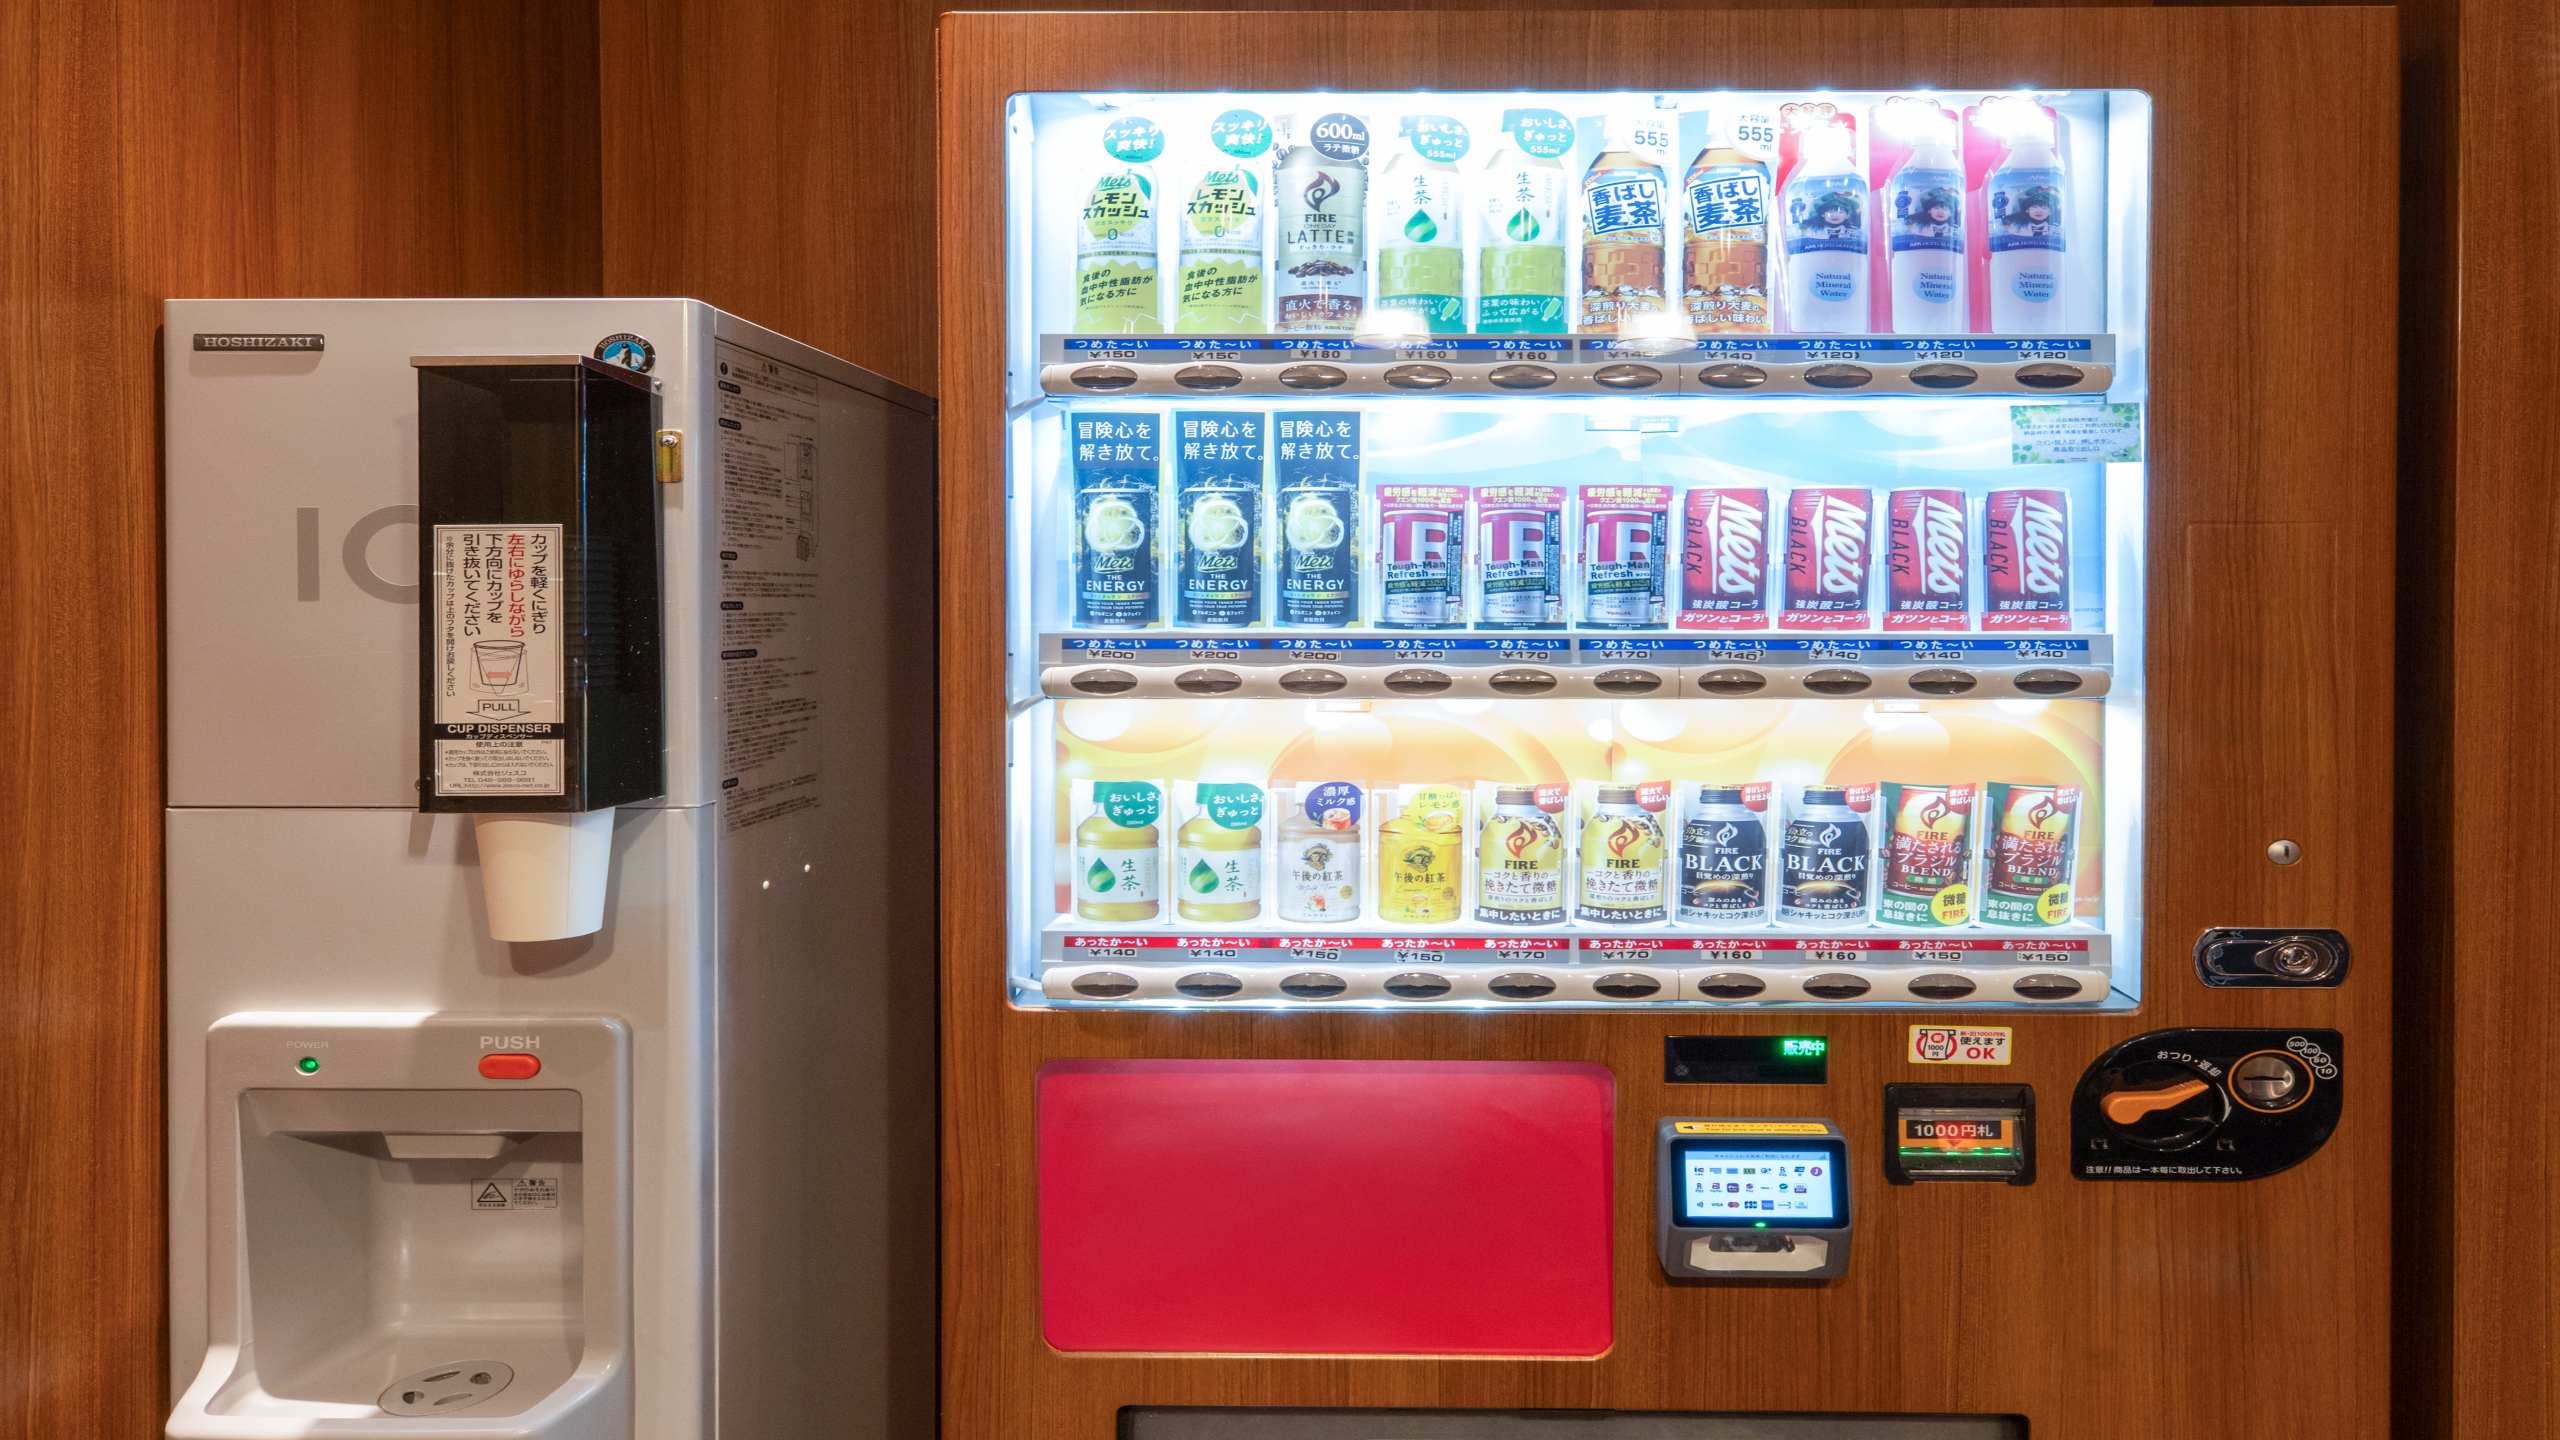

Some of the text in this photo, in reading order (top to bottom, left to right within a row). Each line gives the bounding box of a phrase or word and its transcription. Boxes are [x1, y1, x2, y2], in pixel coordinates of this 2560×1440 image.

[1427, 150, 1456, 159] 555ml
[1530, 146, 1560, 154] 555ml
[1197, 189, 1245, 201] レモン
[1413, 175, 1432, 204] 生茶
[1592, 184, 1654, 206] 香ばし
[1091, 193, 1137, 206] レモン
[1083, 206, 1149, 220] スカッシュ
[1305, 214, 1337, 222] FIRE
[1594, 201, 1658, 229] 麦茶
[1697, 198, 1763, 228] 麦茶
[1288, 229, 1344, 244] LATTE
[1083, 269, 1111, 284] 食後の
[1920, 272, 1952, 280] Natural
[2019, 272, 2052, 280] Natural
[1815, 281, 1852, 289] Mineral
[1920, 282, 1952, 290] Mineral
[1080, 288, 1137, 306] 気になる方に
[1182, 286, 1243, 303] 気になる方に
[1820, 290, 1848, 298] Water
[1924, 290, 1950, 298] Water
[2023, 290, 2050, 298] Water
[1482, 298, 1541, 307] 茶葉の味わい
[1482, 307, 1539, 316] ふって広がる
[204, 338, 312, 347] HOSHIZAKI
[599, 335, 650, 349] HOSHIZAKI
[1807, 351, 1854, 359] ¥120
[1917, 351, 1962, 359] ¥120
[1079, 421, 1151, 439] 冒険心を
[1184, 421, 1256, 438] 冒険心を
[1281, 420, 1351, 438] 冒険心を
[1686, 517, 1703, 574] BLACK
[1789, 517, 1807, 574] BLACK
[1892, 519, 1910, 575] BLACK
[1989, 519, 2008, 575] BLACK
[486, 534, 503, 623] 下方向にカップを
[1388, 571, 1428, 579] Refresh
[1486, 570, 1527, 579] Refresh
[1591, 571, 1633, 579] Refresh
[463, 534, 480, 636] 引き抜いてください
[508, 534, 525, 637] 左右にゆらしながら
[531, 534, 548, 634] カップを軽くにぎり
[1087, 581, 1145, 591] ENERGY
[1189, 580, 1248, 590] ENERGY
[1287, 580, 1344, 590] ENERGY
[1692, 600, 1758, 609] 強炭酸コーラ
[1795, 600, 1861, 609] 強炭酸コーラ
[1901, 601, 1963, 610] 強炭酸コーラ
[2000, 601, 2063, 610] 強炭酸コーラ
[1089, 650, 1134, 659] ¥200
[1192, 651, 1238, 659] ¥200
[1502, 651, 1548, 659] ¥170
[1712, 651, 1757, 660] ¥140
[2018, 650, 2063, 658] ¥140
[482, 703, 516, 711] PULL
[448, 724, 551, 733] CUP DISPENSER
[1323, 786, 1349, 796] 濃厚
[1316, 798, 1356, 806] ミルク感
[1113, 805, 1156, 816] ぎゅっと
[1917, 831, 1948, 840] FIRE
[2023, 831, 2054, 840] FIRE
[1896, 836, 1961, 854] 満たされる
[2003, 836, 2066, 853] 満たされる
[1505, 860, 1538, 869] FIRE
[1607, 859, 1639, 868] FIRE
[1685, 854, 1763, 872] BLACK
[1787, 854, 1865, 873] BLACK
[1898, 853, 1956, 866] ブラジル
[2004, 852, 2062, 866] ブラジル
[1121, 859, 1140, 891] 生茶
[1225, 860, 1243, 891] 生茶
[1292, 870, 1343, 881] 午後の紅茶
[1901, 866, 1951, 876] BLEND
[2007, 865, 2056, 876] BLEND
[1394, 872, 1445, 883] 午後の紅茶
[1696, 873, 1753, 881] 目覚めの深煎り
[1798, 872, 1856, 881] 目覚めの深煎り
[1586, 877, 1658, 892] 挽きたて微糖
[1479, 908, 1560, 921] 集中したいときに
[1581, 907, 1662, 920] 集中したいときに
[1883, 909, 1928, 922] 息抜きに
[1942, 909, 1965, 920] FIRE
[1987, 910, 2033, 922] 息抜きに
[2047, 908, 2068, 919] FIRE
[1816, 952, 1856, 960] ¥160
[480, 1036, 540, 1049] PUSH
[1784, 1040, 1825, 1055] 販売中
[1967, 1047, 1995, 1059] OK
[1915, 1125, 1993, 1137] 1000円札
